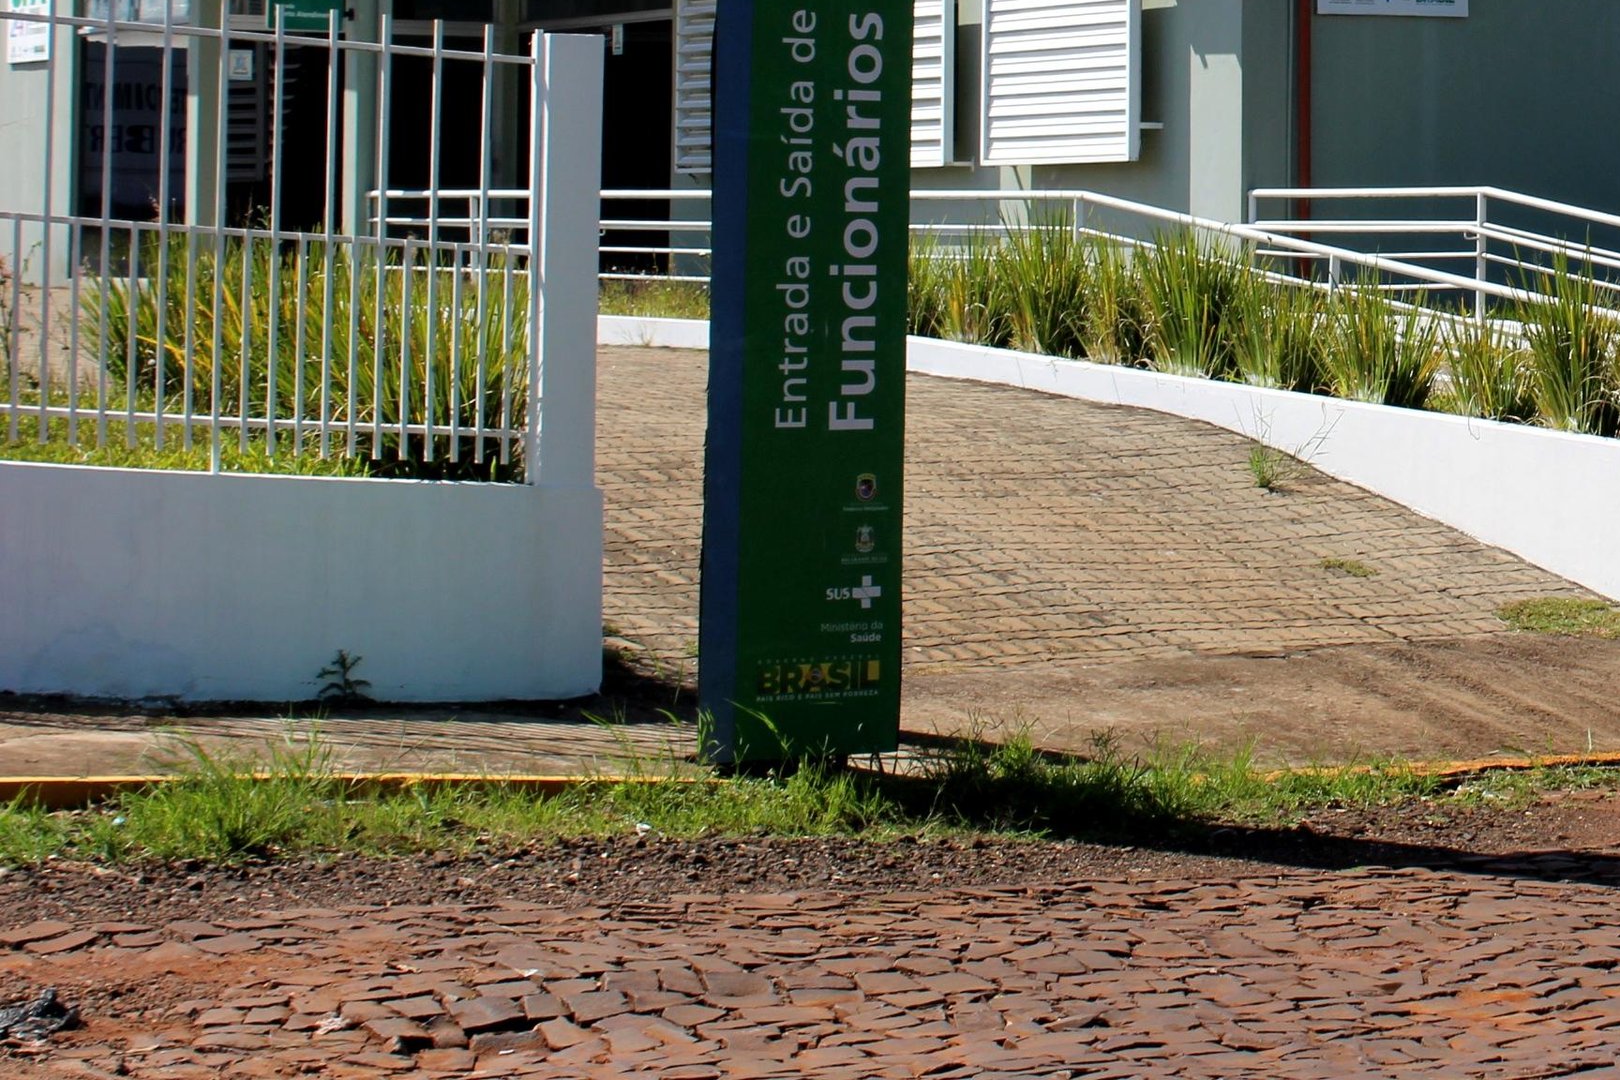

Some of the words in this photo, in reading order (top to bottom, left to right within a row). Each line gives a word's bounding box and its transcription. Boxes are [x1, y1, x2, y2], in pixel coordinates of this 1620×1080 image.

[781, 9, 817, 63] de
[779, 81, 814, 198] Saída
[786, 214, 811, 239] e
[828, 12, 884, 431] Funcionários
[775, 256, 810, 428] Entrada
[826, 588, 850, 600] SUS
[850, 633, 882, 643] Saúde
